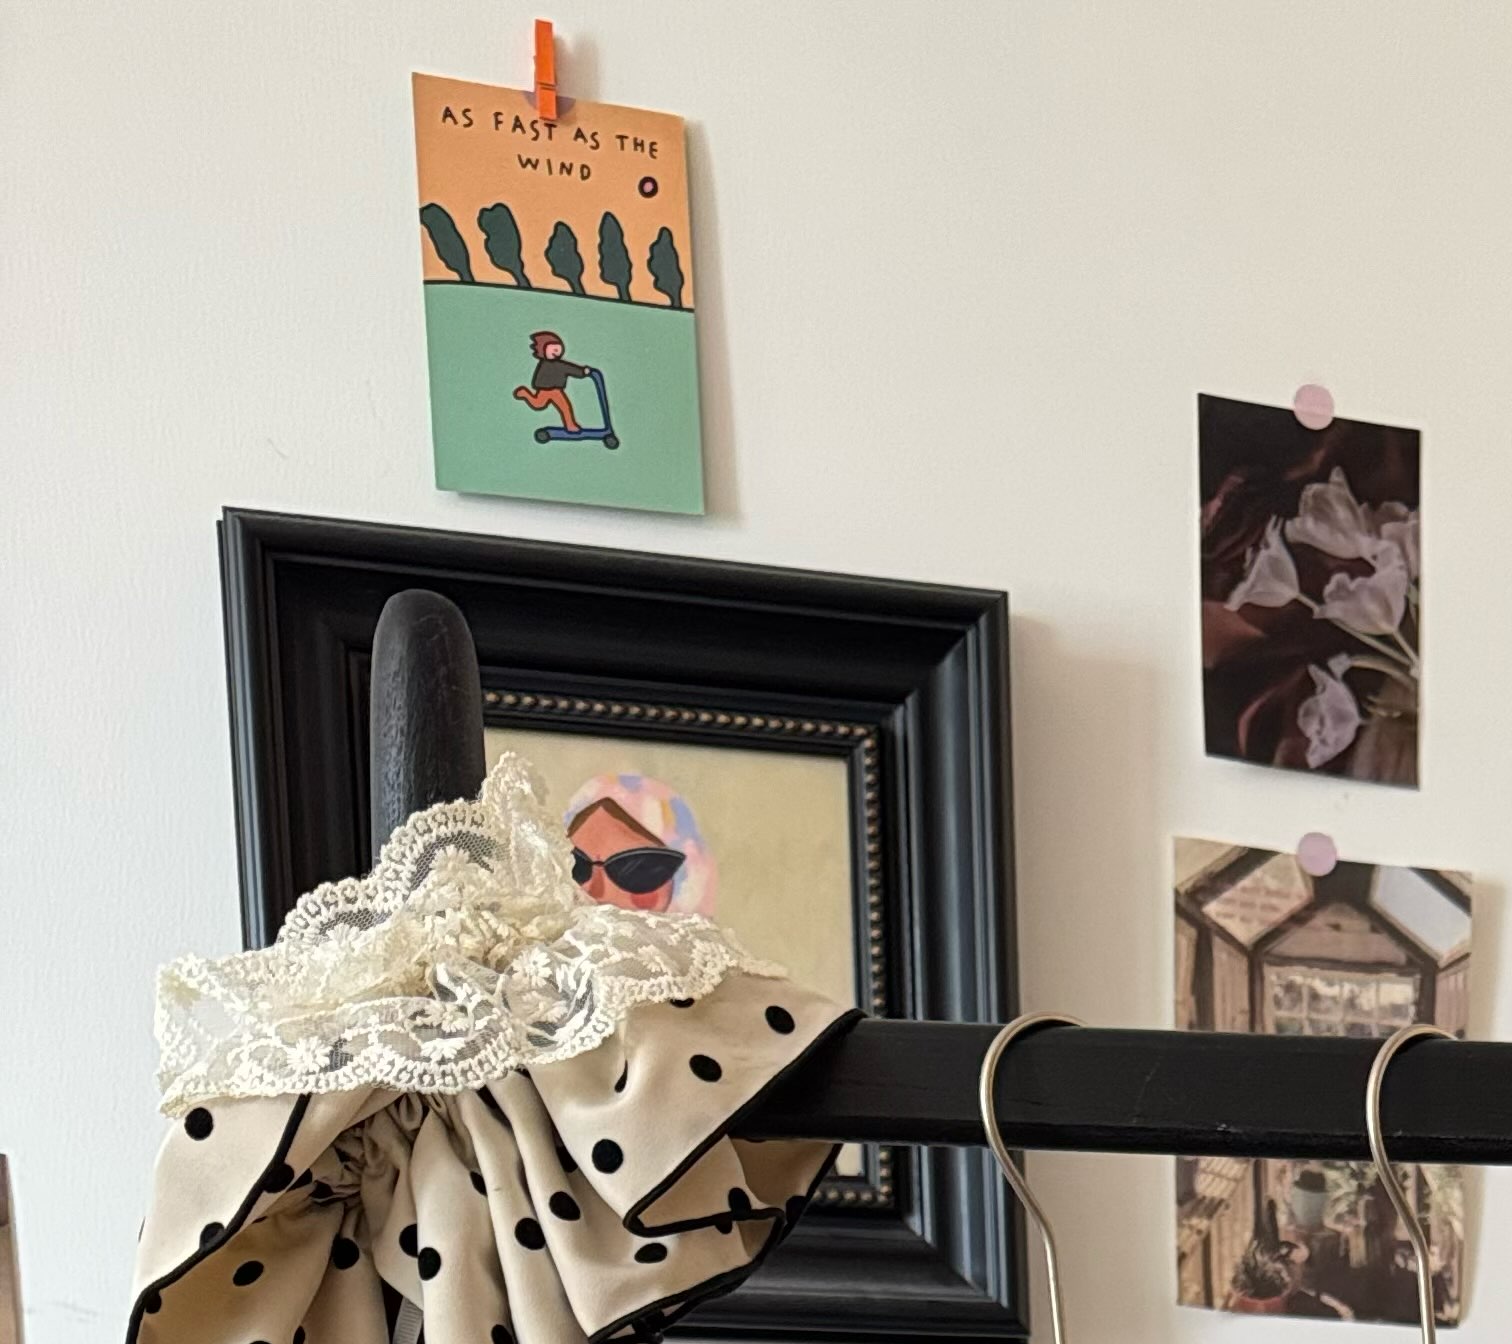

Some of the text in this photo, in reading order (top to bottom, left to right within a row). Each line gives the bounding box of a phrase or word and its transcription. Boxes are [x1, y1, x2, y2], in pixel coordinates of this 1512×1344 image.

[441, 106, 659, 160] AS FAST AS THE
[517, 153, 592, 181] WIND
